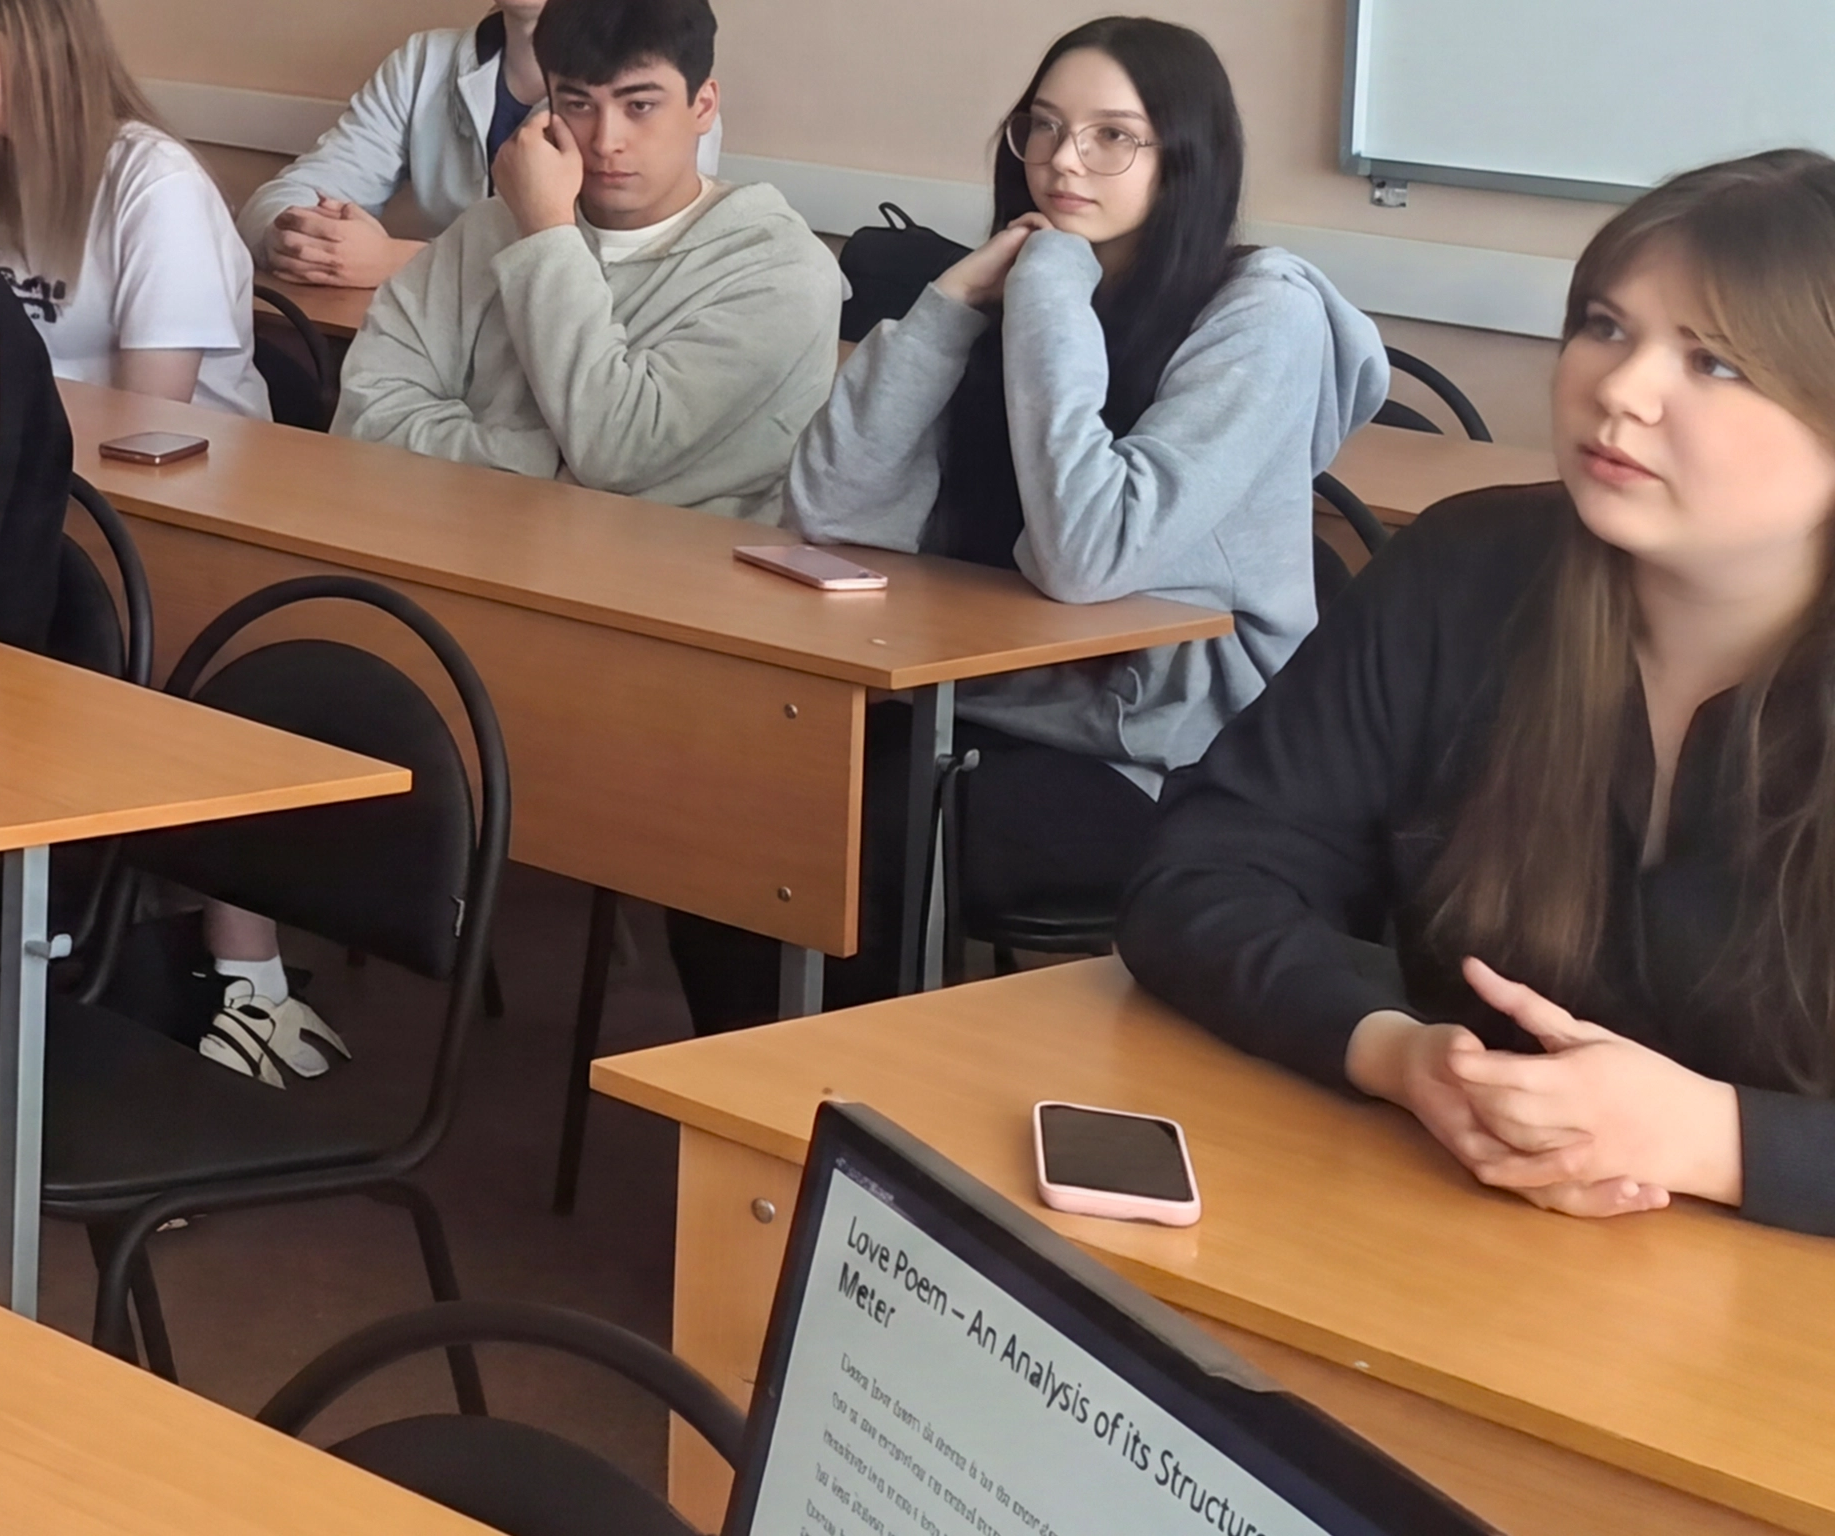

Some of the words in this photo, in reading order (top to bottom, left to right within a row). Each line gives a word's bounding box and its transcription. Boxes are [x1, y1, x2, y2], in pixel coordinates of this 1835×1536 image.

[838, 1262, 896, 1329] Meter
[846, 1215, 891, 1272] Love
[893, 1250, 948, 1316] Poem
[966, 1309, 997, 1355] An
[999, 1333, 1090, 1424] Analysis
[1093, 1410, 1125, 1447] of
[1122, 1422, 1152, 1472] its
[1154, 1449, 1266, 1536] Structur
